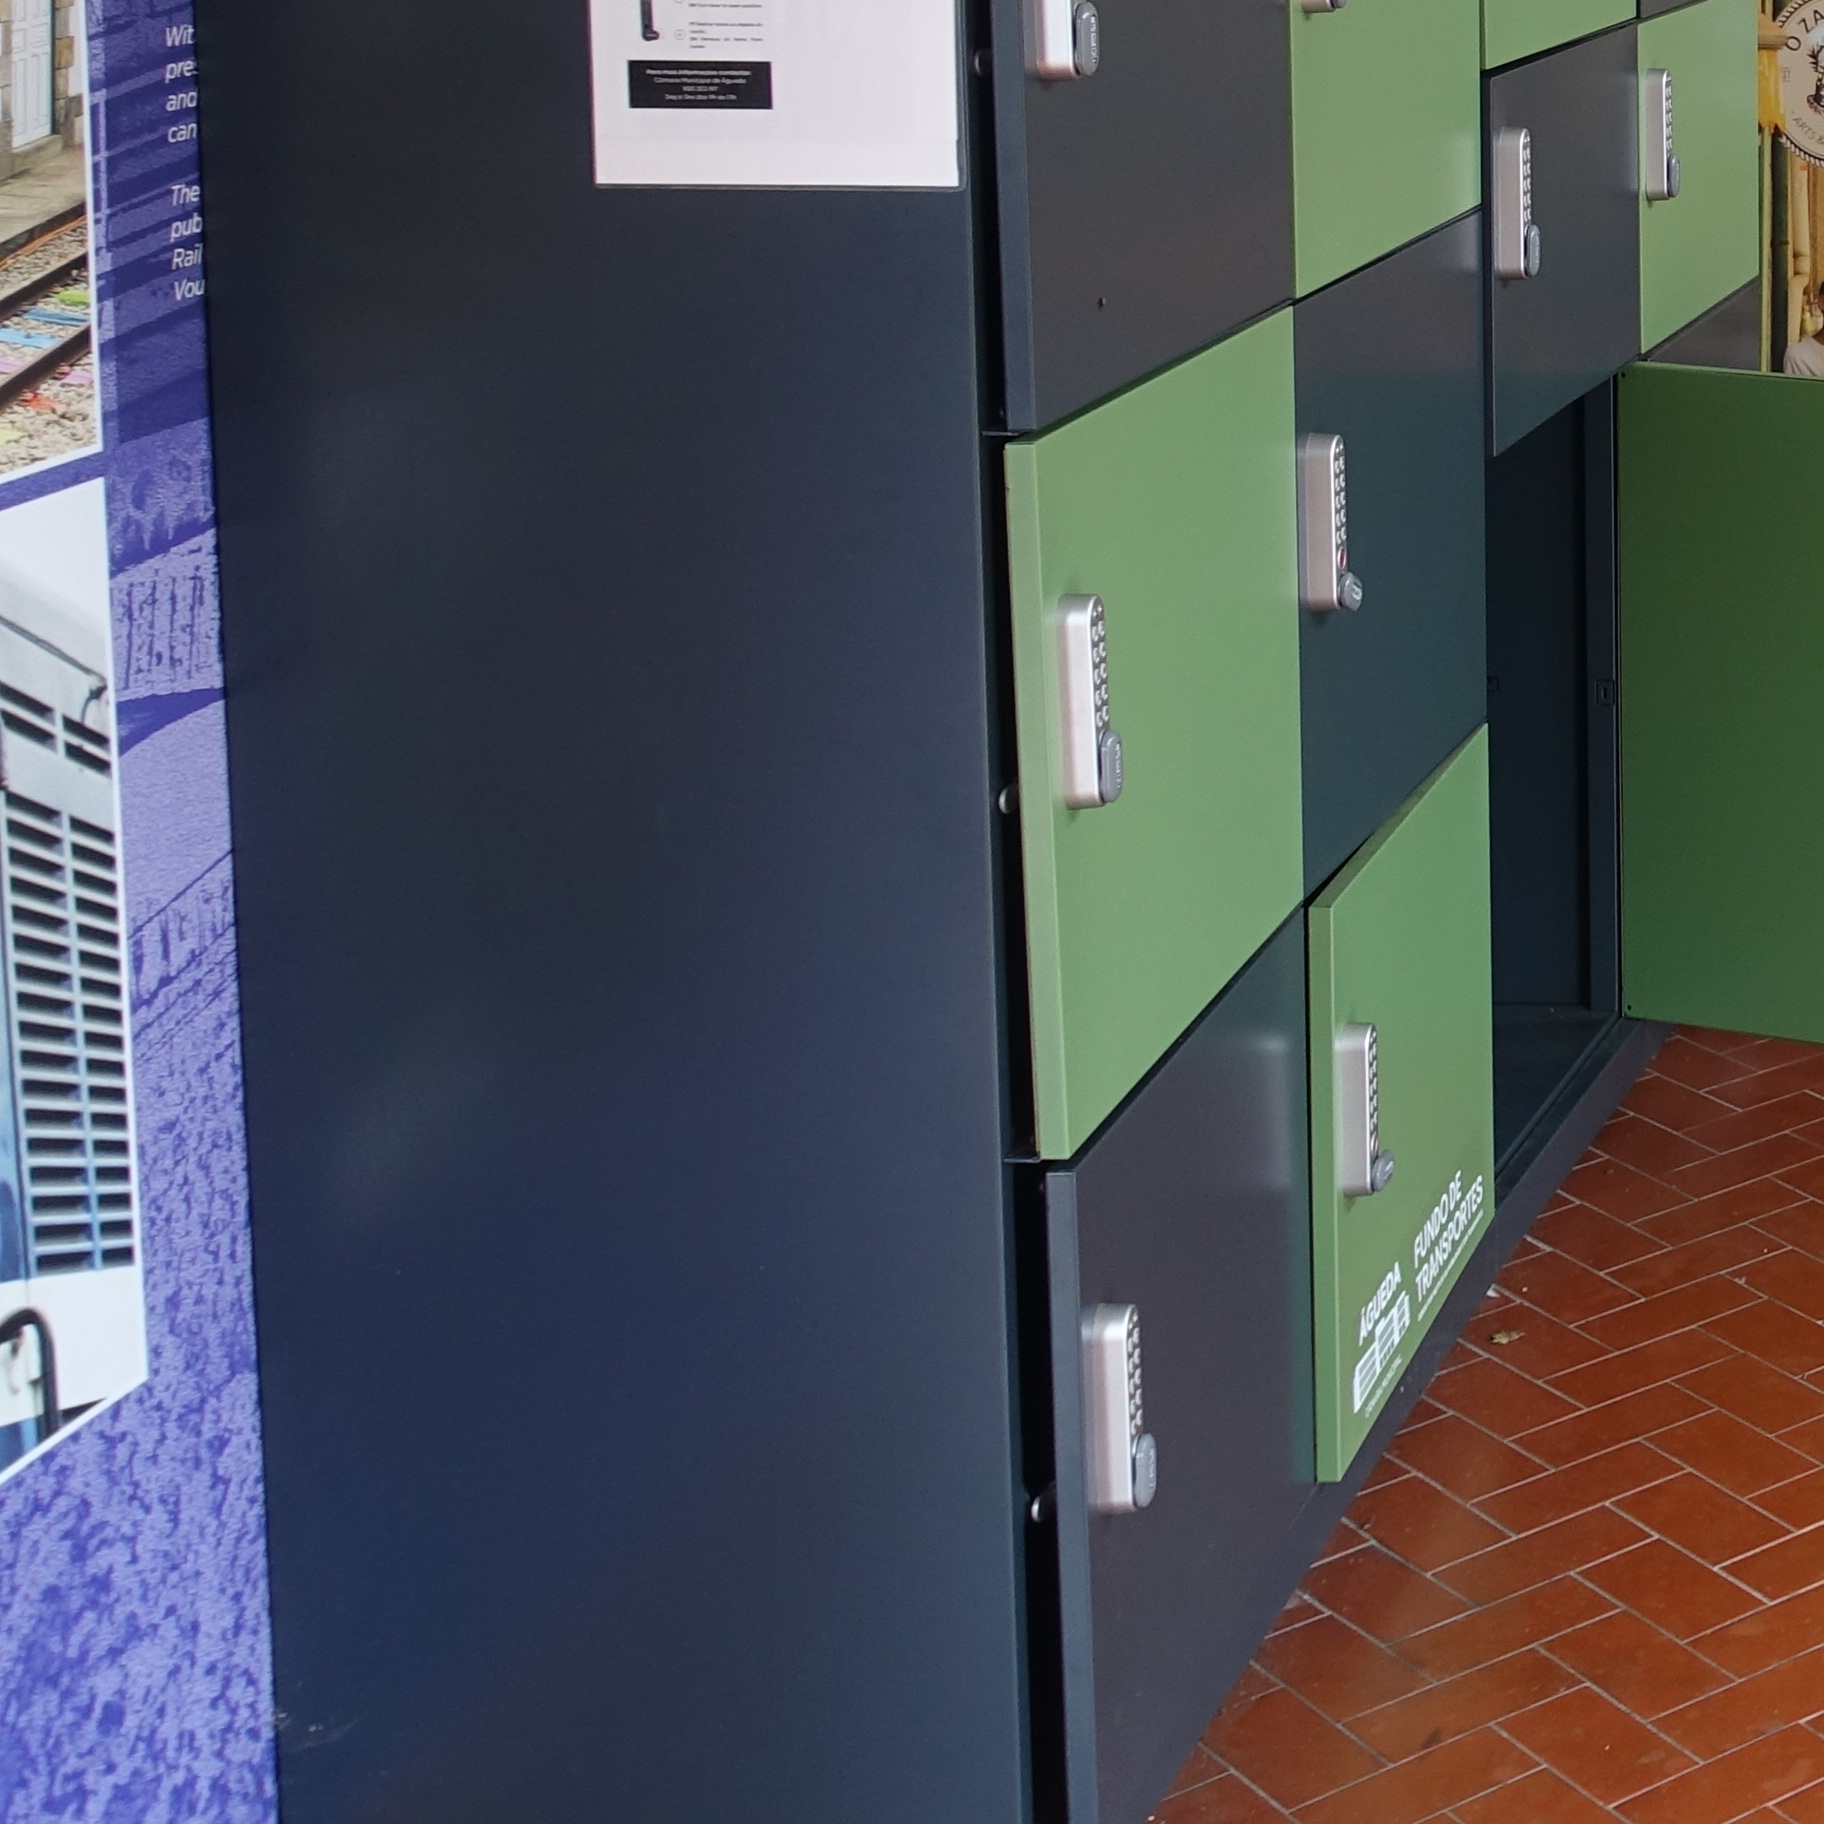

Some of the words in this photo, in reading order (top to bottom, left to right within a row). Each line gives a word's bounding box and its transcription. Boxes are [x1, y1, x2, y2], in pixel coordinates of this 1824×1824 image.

[1785, 36, 1801, 52] O
[1793, 116, 1816, 140] ARTS
[1413, 1196, 1450, 1269] FUNDO
[1449, 1169, 1463, 1204] DE
[1415, 1175, 1484, 1303] TRANSPORTES
[1358, 1260, 1403, 1347] ÁGUEDA
